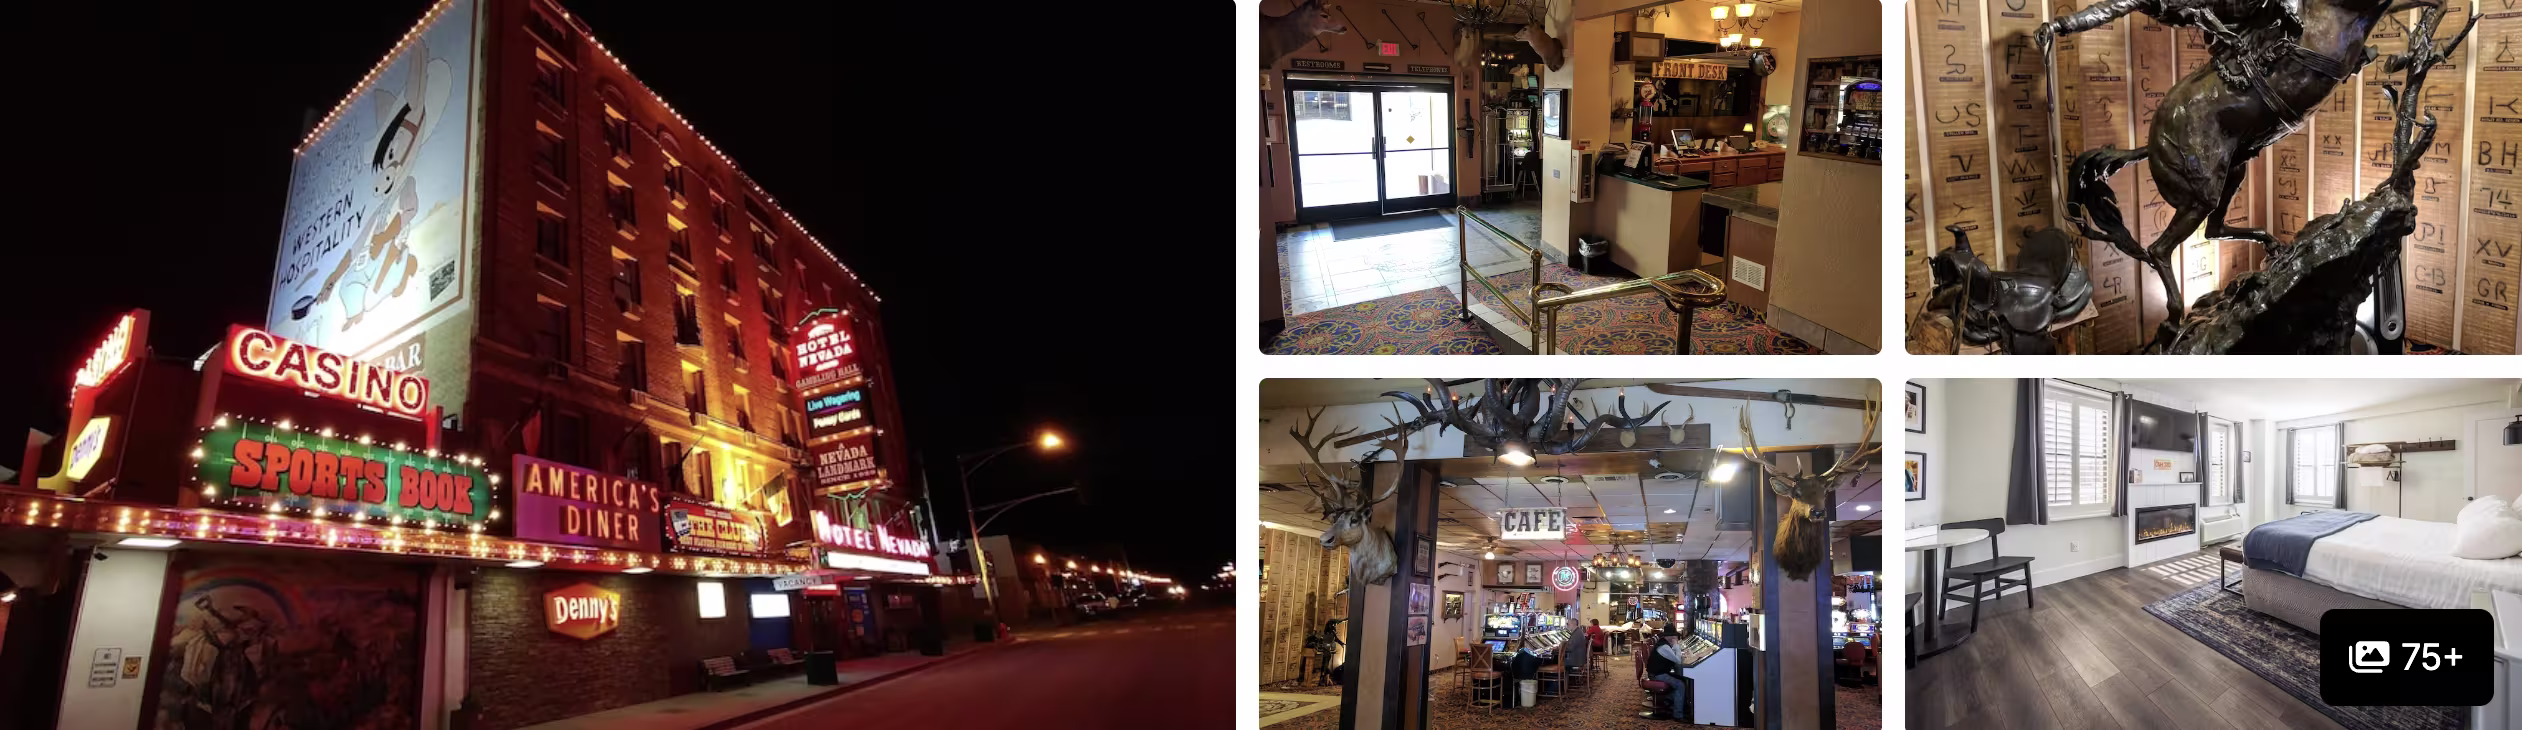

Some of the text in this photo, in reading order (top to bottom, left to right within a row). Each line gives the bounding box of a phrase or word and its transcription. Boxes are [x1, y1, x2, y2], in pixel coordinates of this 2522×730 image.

[1382, 43, 1397, 55] EXIT
[1296, 60, 1341, 69] RESTROOMS
[1655, 62, 1727, 80] FRONT DESK
[292, 188, 354, 255] WESTERN
[279, 205, 367, 287] HOSPITALITY
[384, 342, 423, 372] BAR
[796, 330, 850, 357] HOTEL
[798, 343, 853, 368] NEVADA
[238, 331, 427, 411] CASINO
[795, 362, 861, 389] GAMBLING HALL
[807, 390, 861, 412] Live Wagering
[817, 457, 876, 479] LANDMARK
[819, 445, 868, 466] NEVADA
[230, 438, 474, 514] SPORTS BOOK
[526, 463, 659, 512] AMERICA'S
[567, 505, 640, 542] DINER
[816, 511, 931, 558] HOTEL NEVADA
[1504, 510, 1562, 532] CAFE
[779, 577, 816, 589] VACANCY
[553, 592, 618, 625] Denny's
